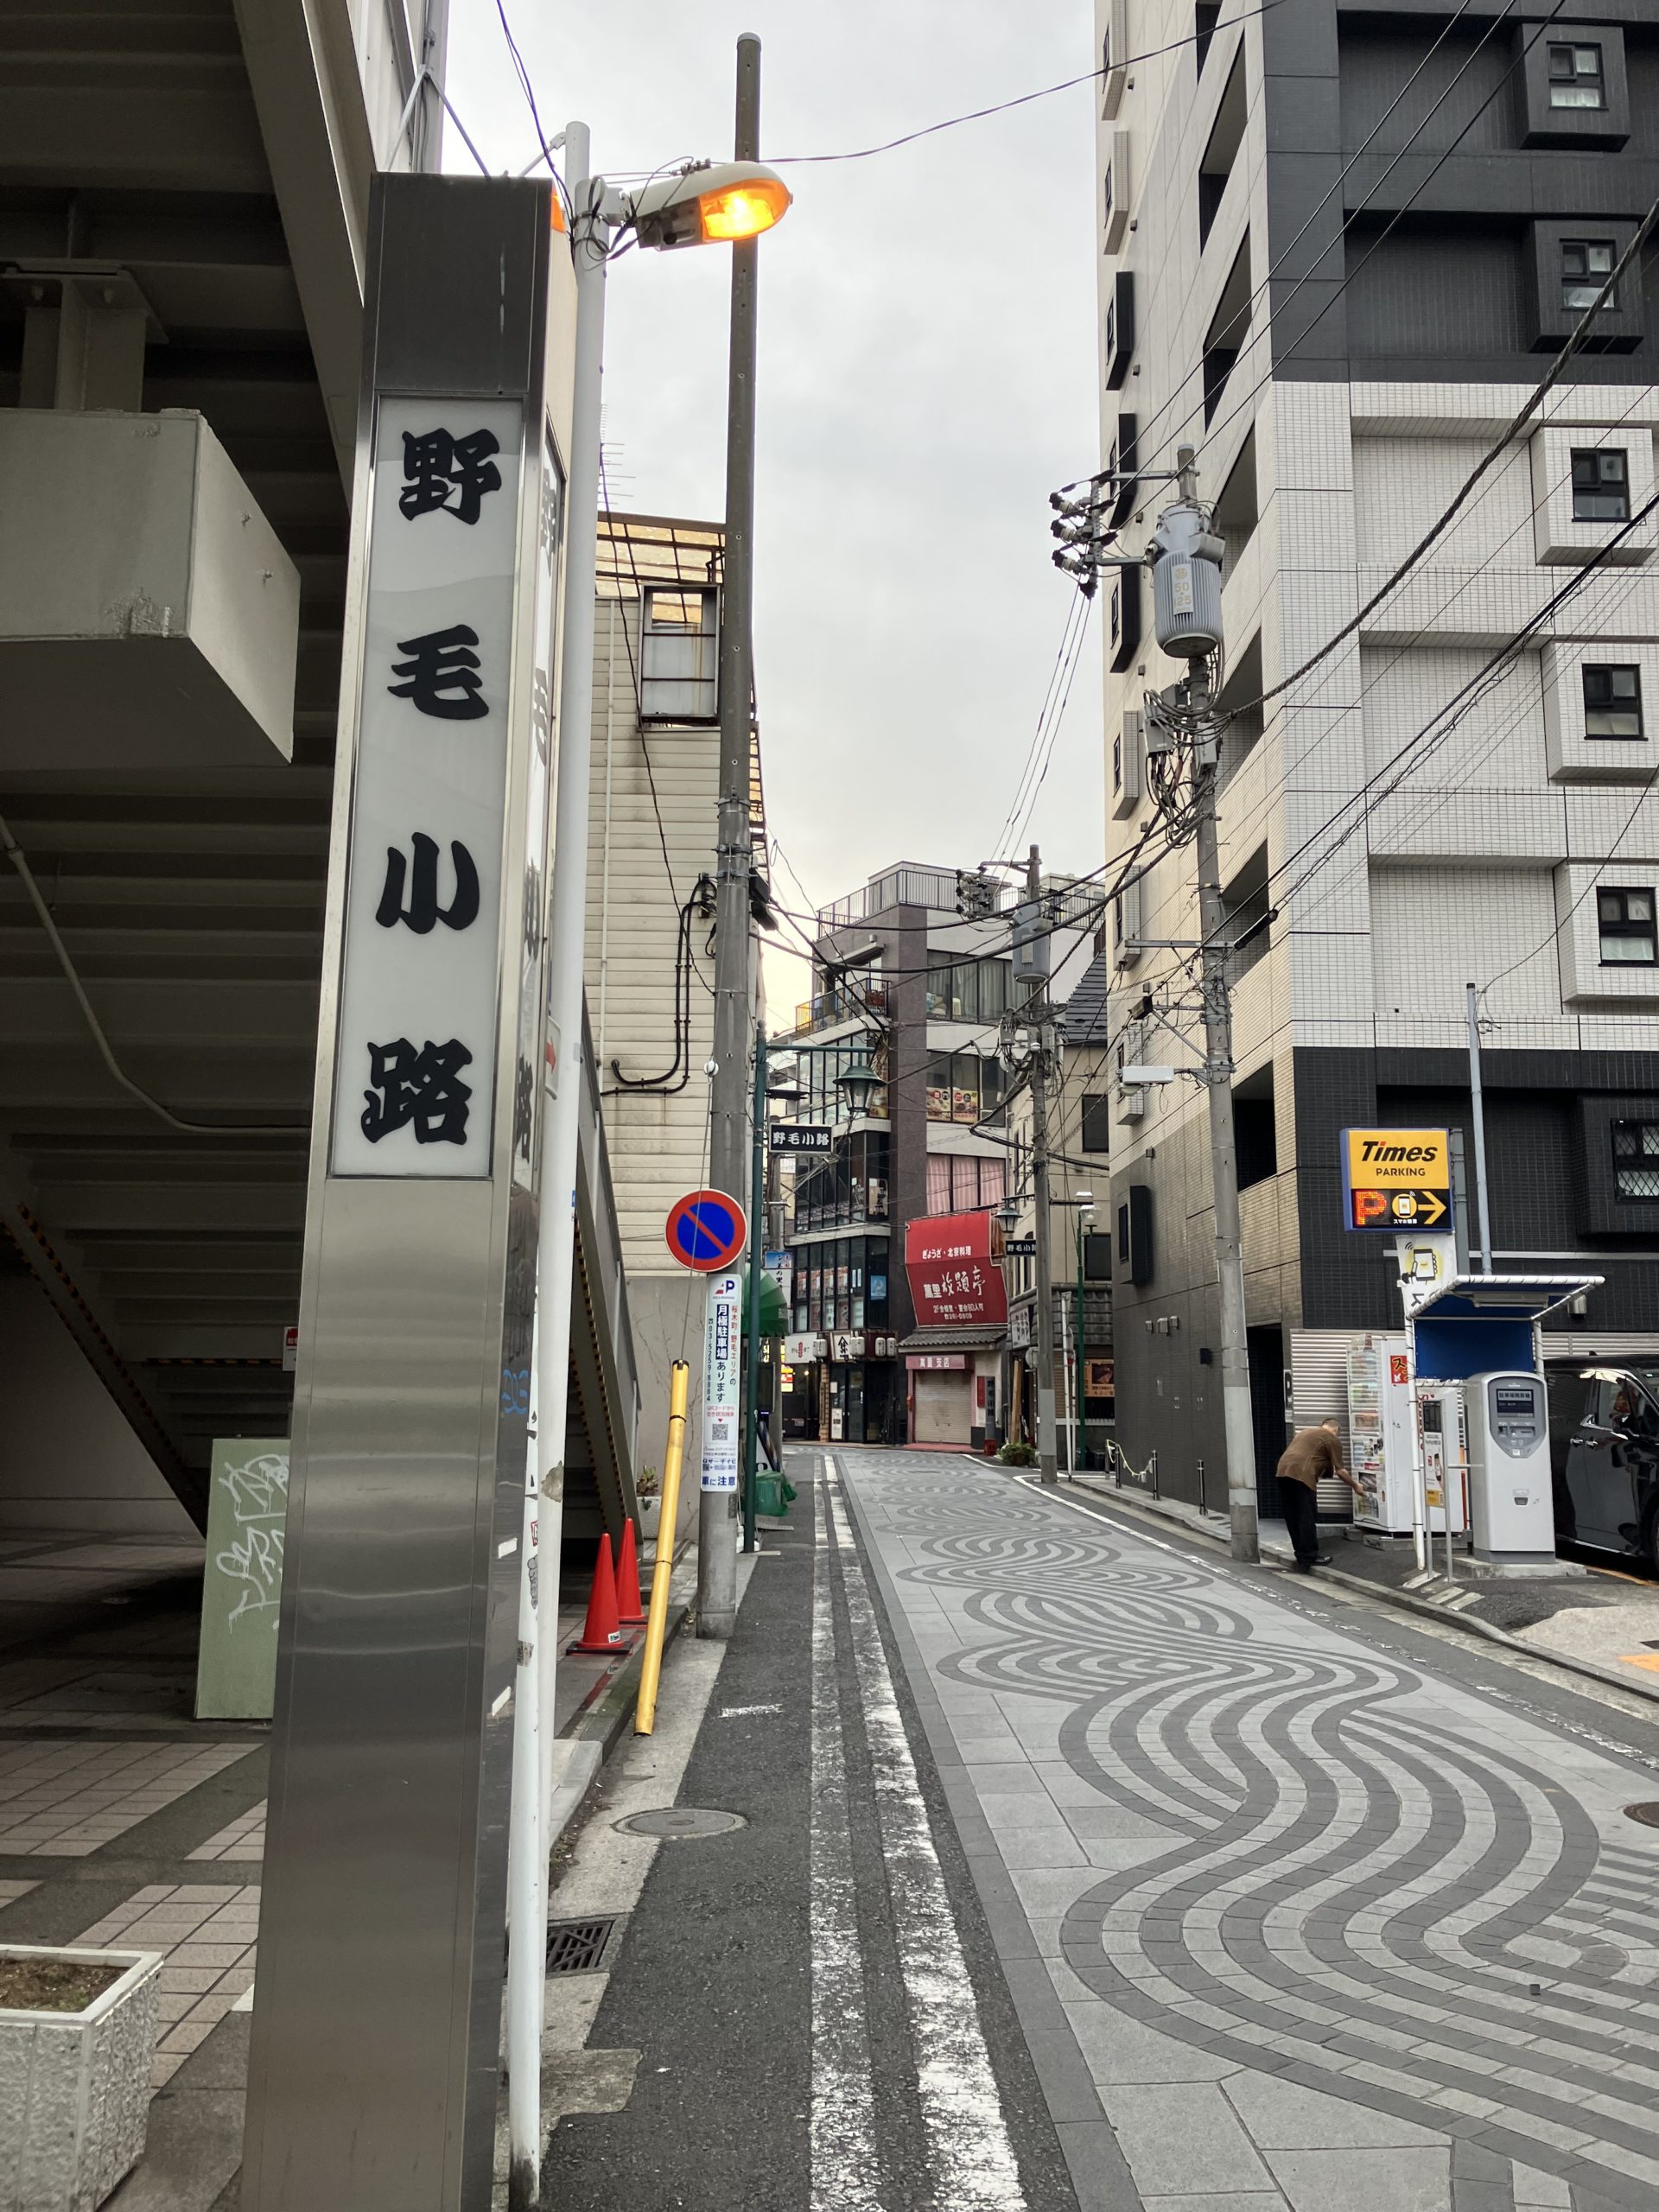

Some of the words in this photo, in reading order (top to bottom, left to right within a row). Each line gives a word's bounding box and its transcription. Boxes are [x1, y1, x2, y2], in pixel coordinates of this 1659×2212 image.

[362, 427, 501, 1146] 野毛小路
[772, 1131, 830, 1146] 野毛小路
[1361, 1141, 1438, 1162] Times
[1376, 1167, 1426, 1176] PARKING
[1355, 1190, 1387, 1225] P
[702, 1476, 735, 1486] 車に注意
